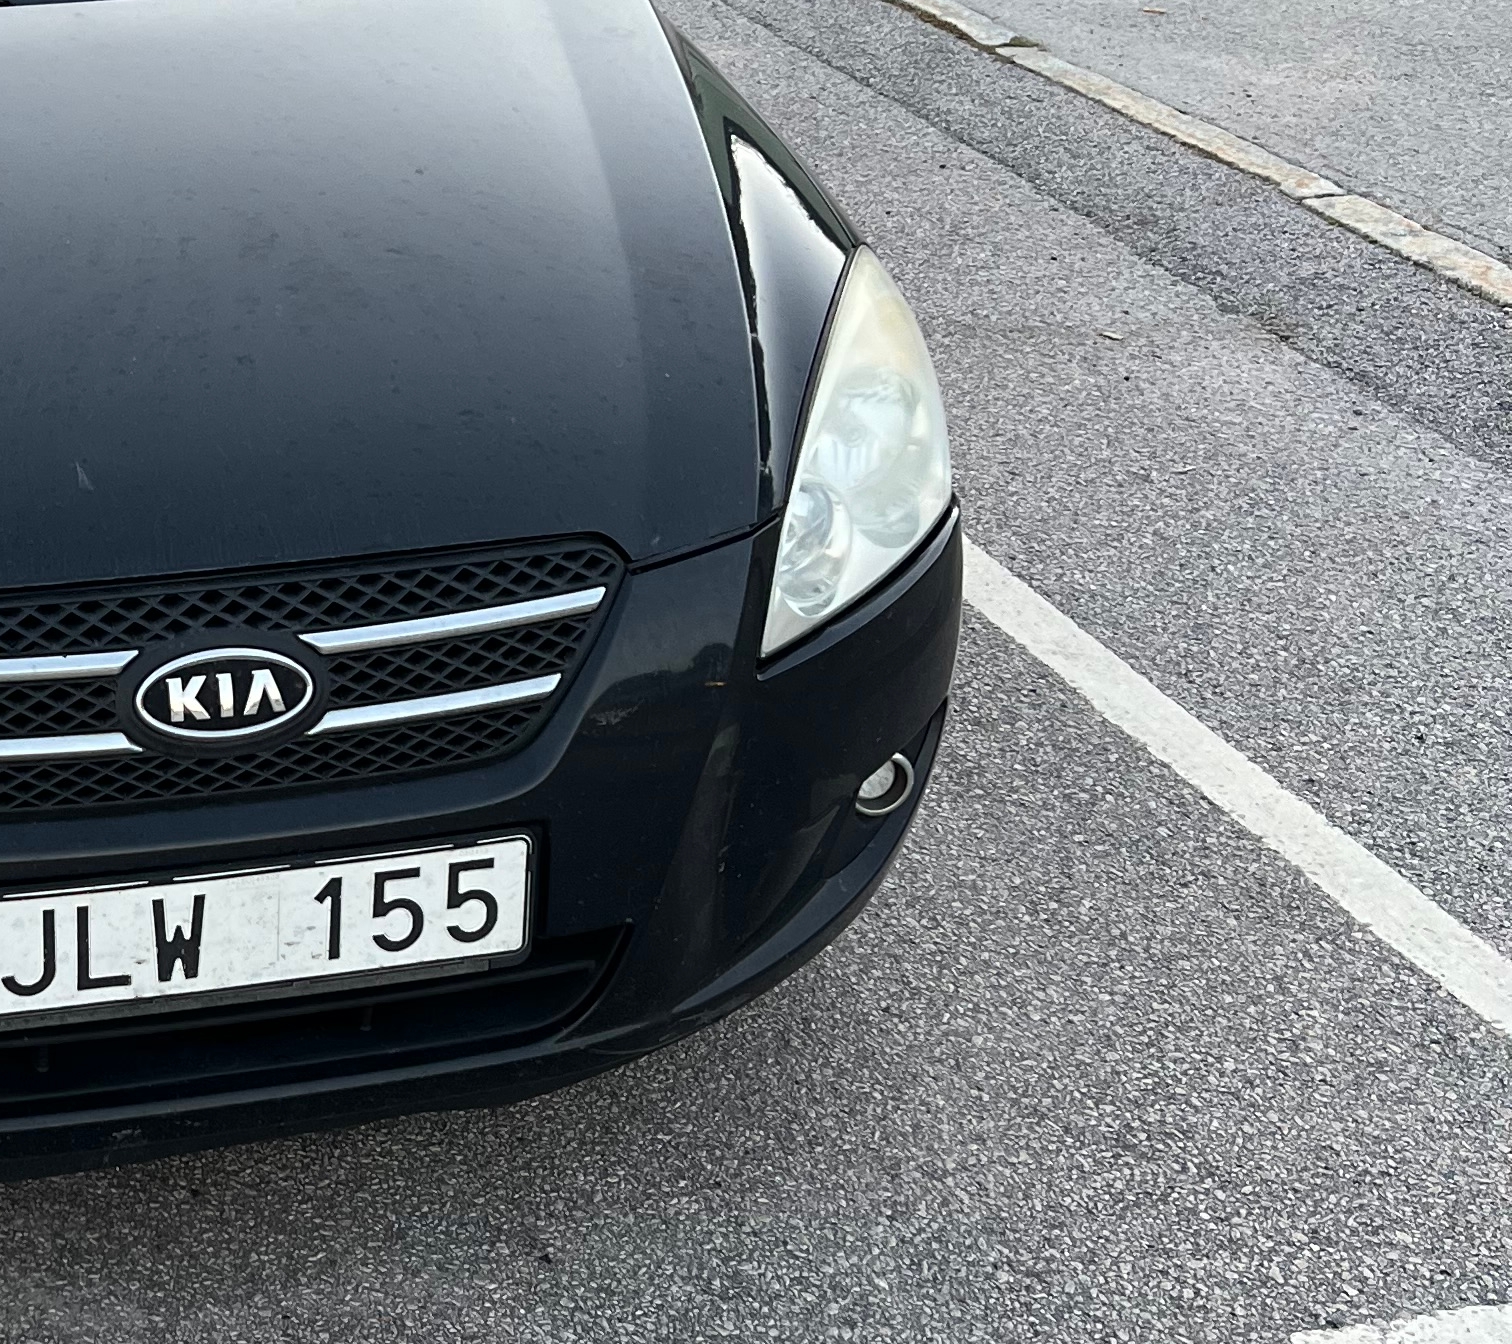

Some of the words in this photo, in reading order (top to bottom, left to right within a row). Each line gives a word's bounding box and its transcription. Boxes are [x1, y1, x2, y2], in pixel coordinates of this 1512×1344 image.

[165, 668, 287, 723] KIA
[1, 893, 207, 997] JLW
[313, 858, 499, 961] 155
